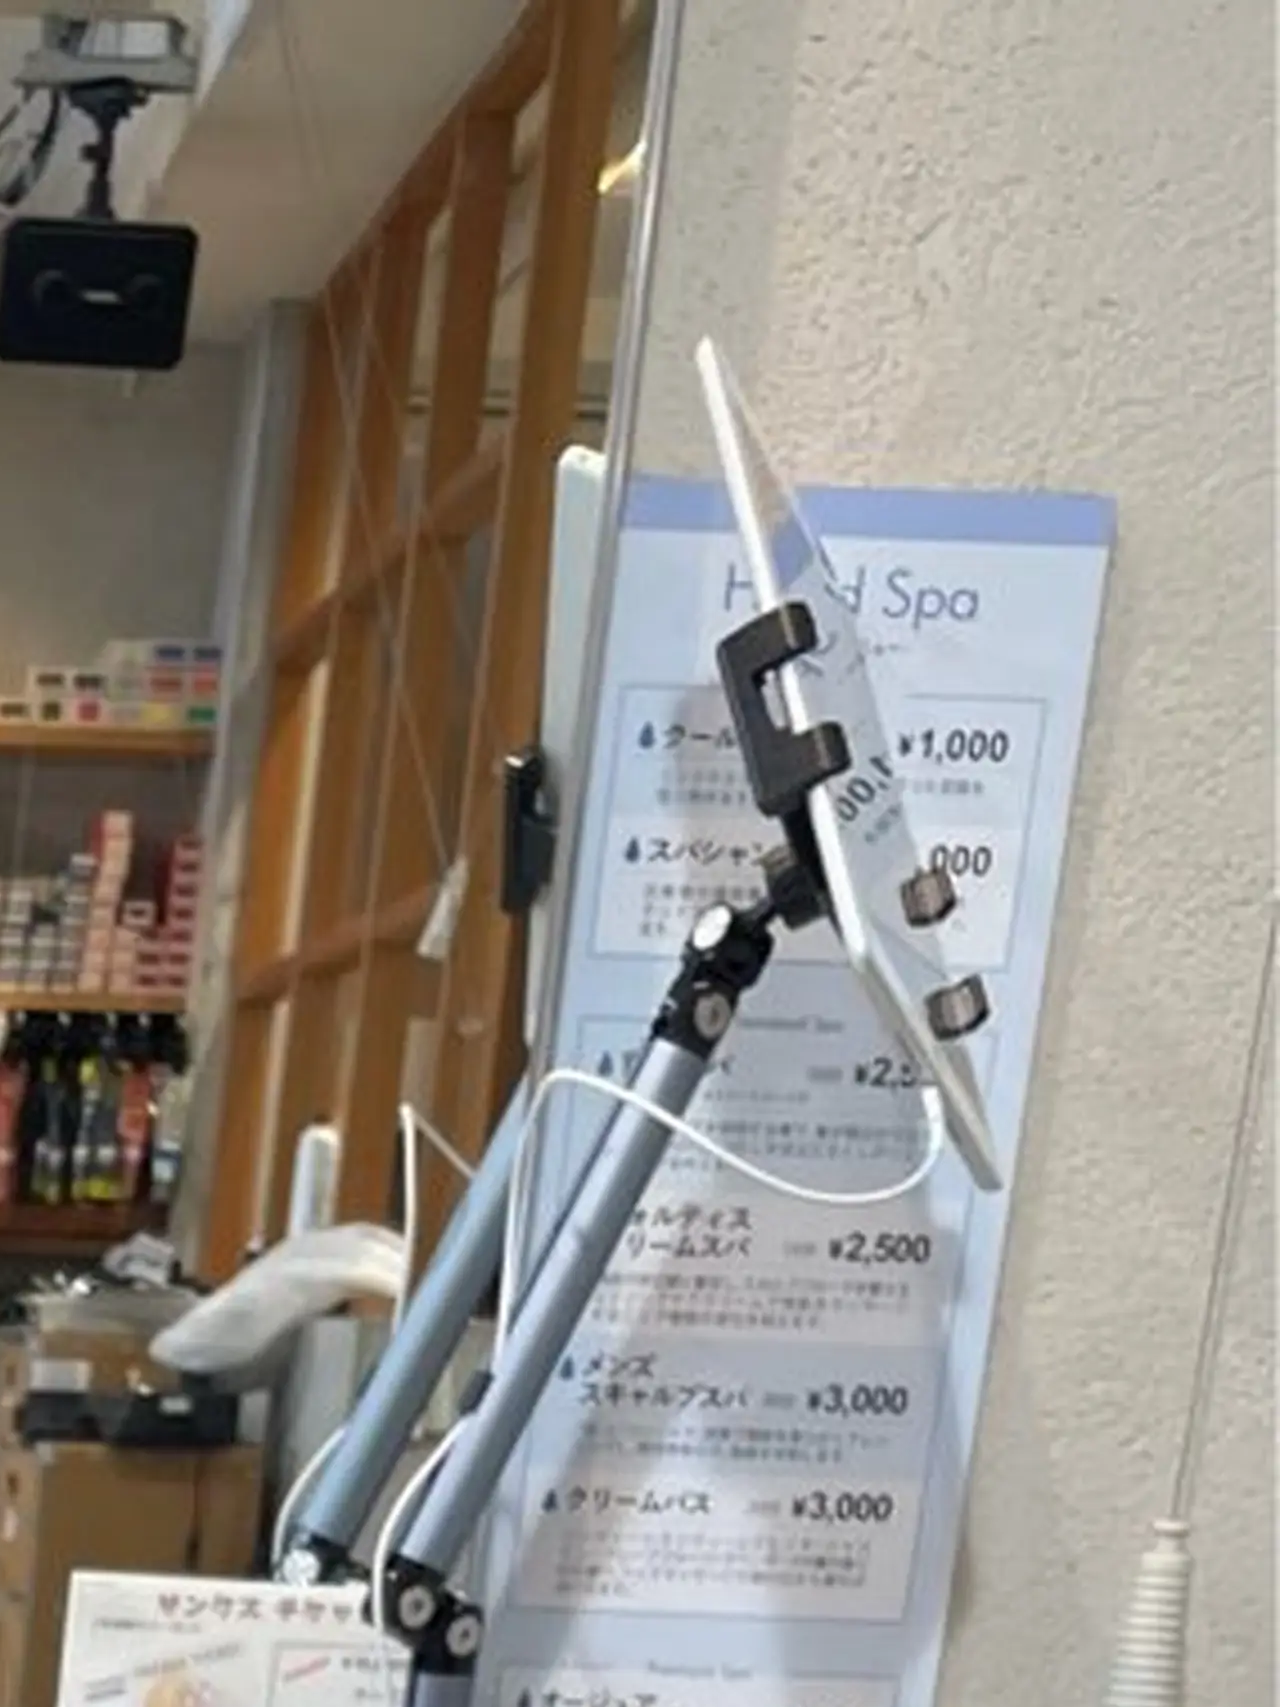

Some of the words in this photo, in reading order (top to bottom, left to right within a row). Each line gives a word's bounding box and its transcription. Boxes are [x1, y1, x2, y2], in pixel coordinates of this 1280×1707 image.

[882, 568, 980, 630] Spa
[900, 728, 1009, 763] ¥1,000
[829, 1231, 930, 1266] ¥2,500
[806, 1384, 909, 1418] ¥3,000
[792, 1491, 894, 1525] ¥3,000
